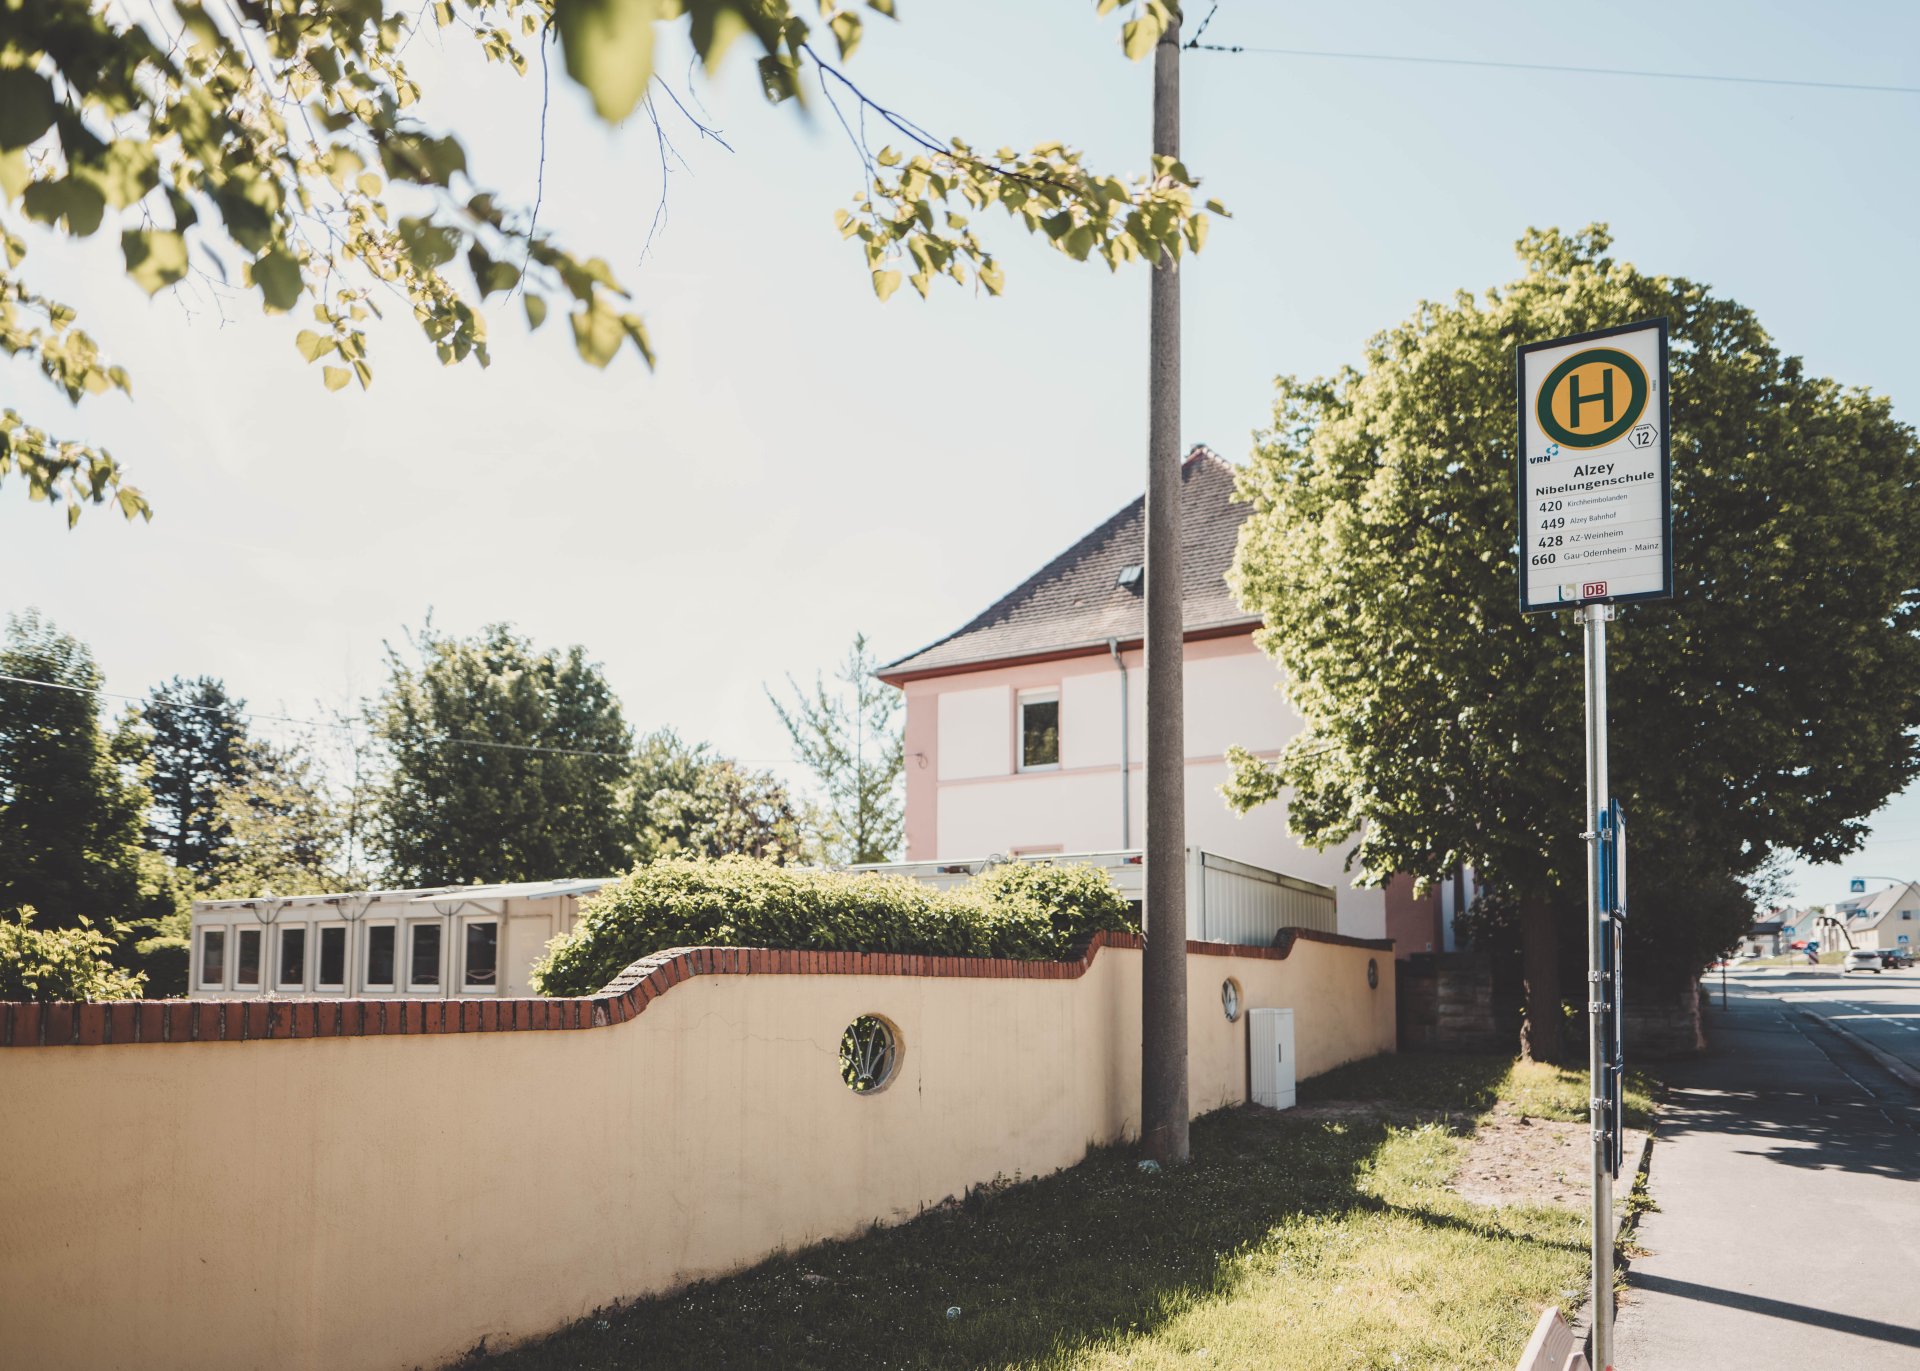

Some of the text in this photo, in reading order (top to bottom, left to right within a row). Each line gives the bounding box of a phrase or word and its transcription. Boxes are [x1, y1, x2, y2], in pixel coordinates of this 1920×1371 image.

[1570, 368, 1613, 428] H
[1636, 431, 1650, 446] 12
[1529, 455, 1551, 465] VRN
[1573, 463, 1615, 478] Alzey
[1535, 471, 1655, 496] Nibelungenschule
[1539, 493, 1628, 513] 420 Kirchheimbolanden
[1541, 511, 1617, 530] 449 Alzey Bahnhof
[1538, 529, 1624, 549] 428 AZ-Weinheim
[1531, 553, 1557, 566] 660
[1563, 546, 1627, 561] Gau-Odernheim
[1634, 541, 1660, 552] Mainz
[1586, 584, 1605, 596] DB
